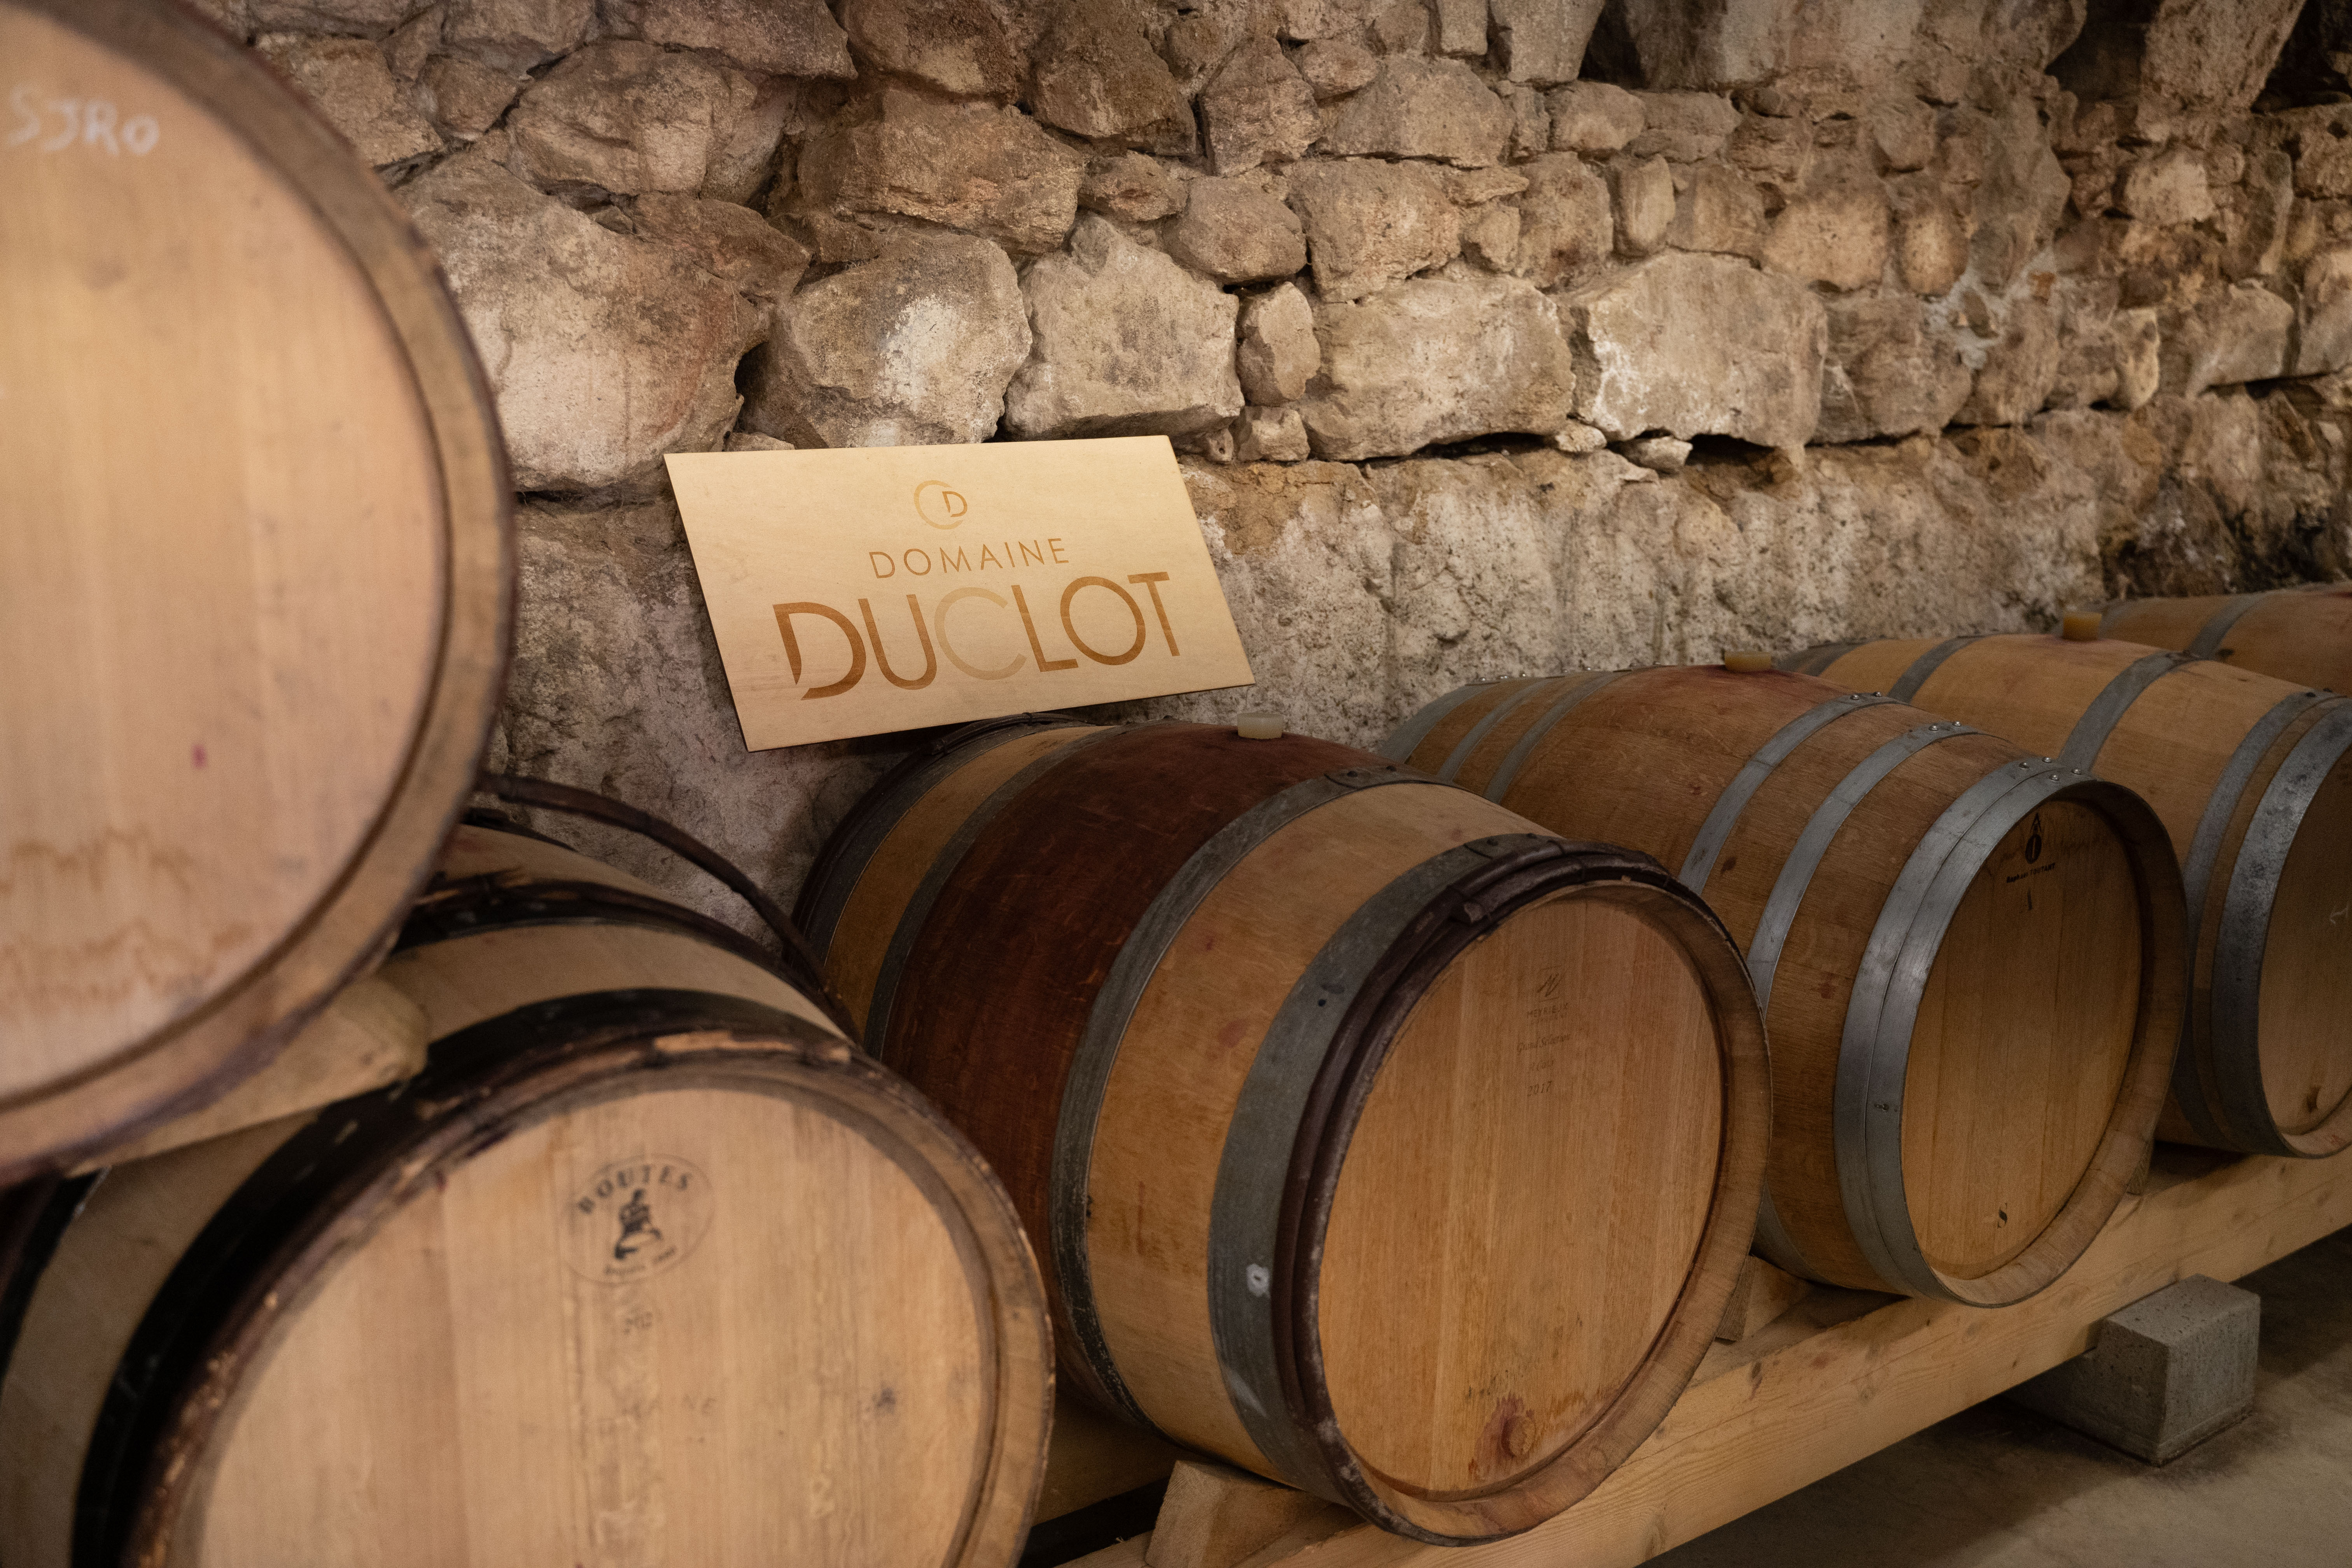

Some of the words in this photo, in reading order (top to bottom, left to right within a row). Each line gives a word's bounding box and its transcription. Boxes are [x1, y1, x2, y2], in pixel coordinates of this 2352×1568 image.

[868, 537, 1069, 579] DOMAINE
[772, 571, 1181, 701] DUCLOT
[1527, 1080, 1553, 1097] 2017
